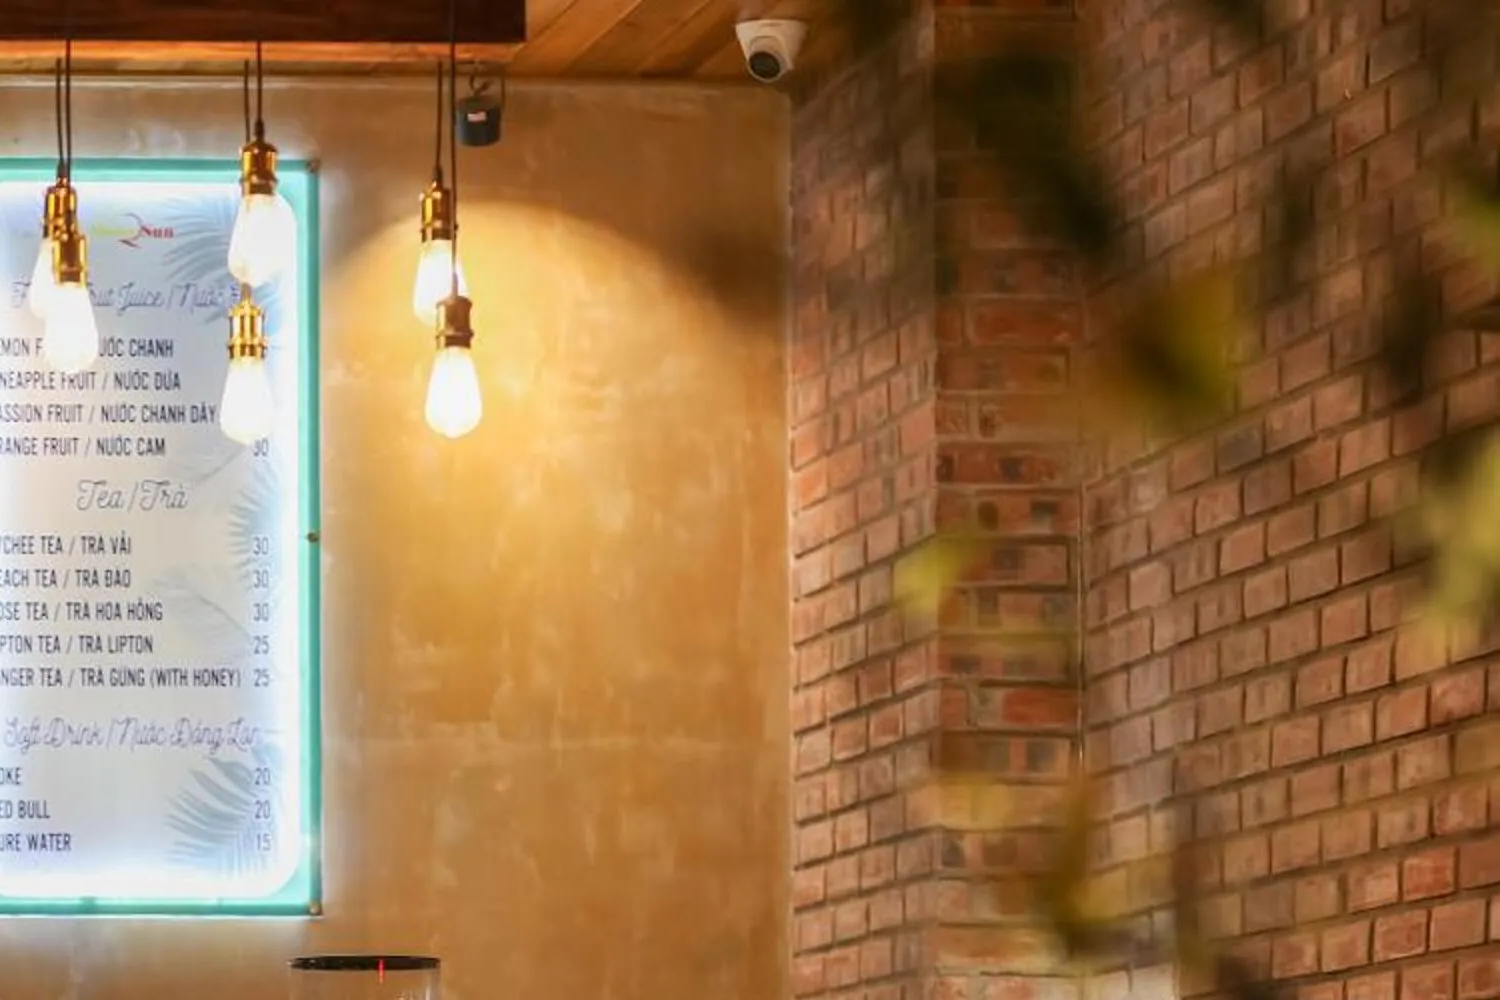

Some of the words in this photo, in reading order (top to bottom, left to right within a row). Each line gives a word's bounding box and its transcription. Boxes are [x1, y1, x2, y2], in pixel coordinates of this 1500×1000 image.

[129, 339, 173, 357] CHANH
[61, 371, 96, 390] FRUIT
[48, 404, 85, 422] FRUIT
[141, 405, 185, 422] CHANH
[42, 438, 80, 455] FRUIT
[137, 438, 165, 455] CAM
[78, 479, 124, 510] Tea
[41, 537, 63, 555] TEA
[253, 538, 269, 554] 30
[34, 570, 57, 588] TEA
[253, 571, 269, 588] 30
[26, 603, 48, 621] TEA
[96, 603, 122, 621] HOA
[253, 604, 269, 621] 30
[38, 636, 60, 652] TEA
[108, 636, 152, 653] LIPTON
[253, 637, 269, 653] 25
[40, 669, 62, 687] TEA
[150, 669, 189, 689] (WITH
[194, 669, 241, 689] HONEY)
[253, 669, 269, 686] 25
[4, 715, 41, 755] Soft
[45, 716, 103, 749] Drink
[255, 768, 270, 785] 20
[18, 801, 50, 818] BULL
[255, 802, 270, 818] 20
[28, 834, 71, 851] WATER
[256, 834, 270, 850] 15
